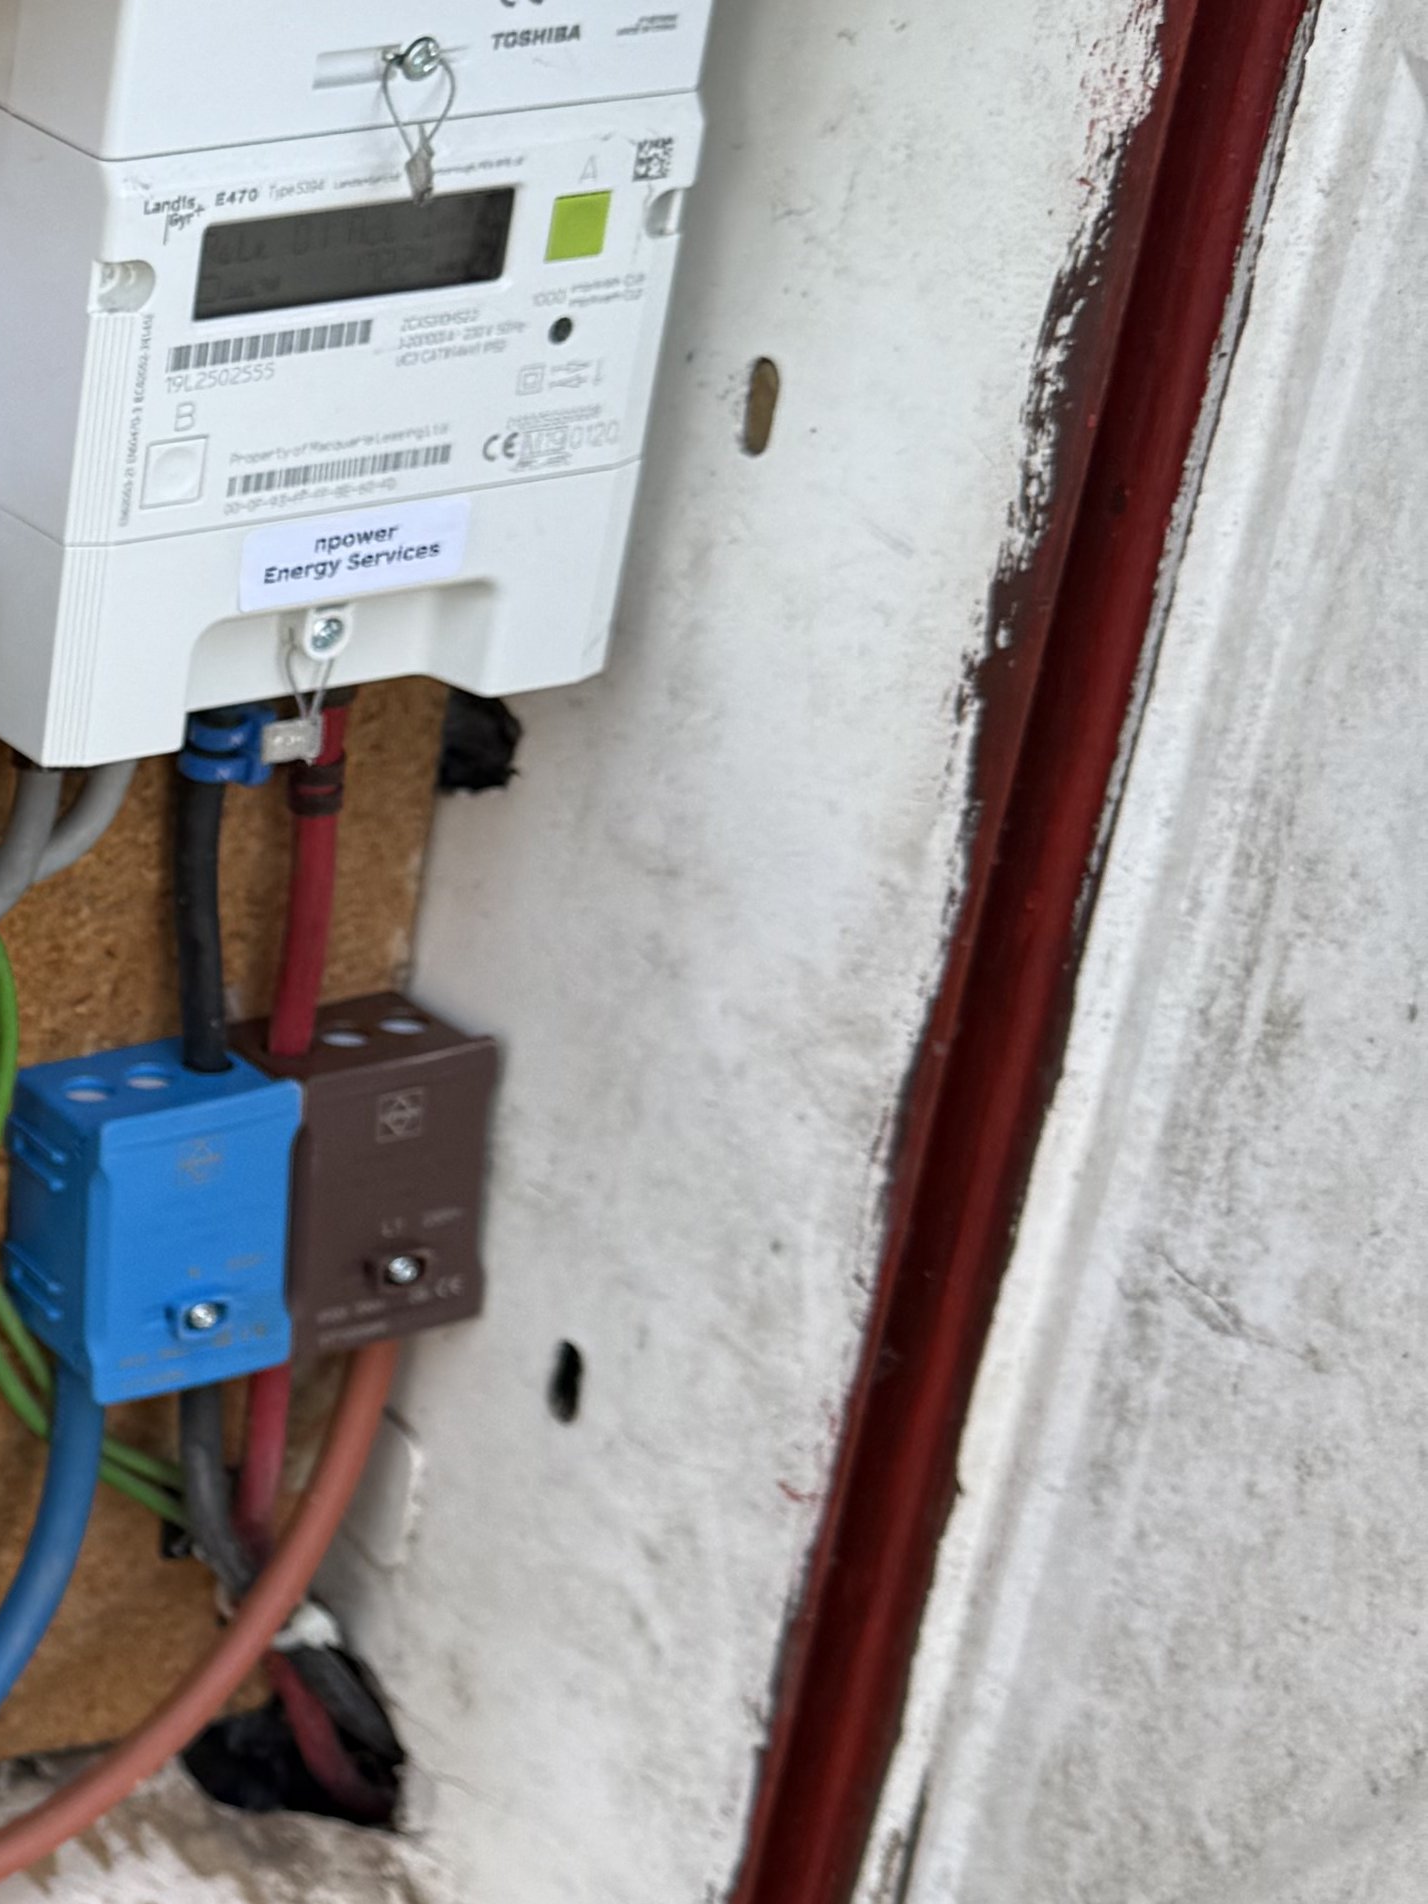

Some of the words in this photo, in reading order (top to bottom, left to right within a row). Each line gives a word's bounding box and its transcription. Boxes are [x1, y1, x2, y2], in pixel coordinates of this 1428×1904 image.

[491, 24, 581, 51] TOSHIBA
[144, 196, 195, 216] Landis
[215, 187, 259, 207] E470
[165, 362, 276, 394] 19L2502555
[174, 401, 195, 432] B
[314, 524, 400, 554] npower
[263, 558, 343, 585] Energy
[347, 541, 441, 572] Services
